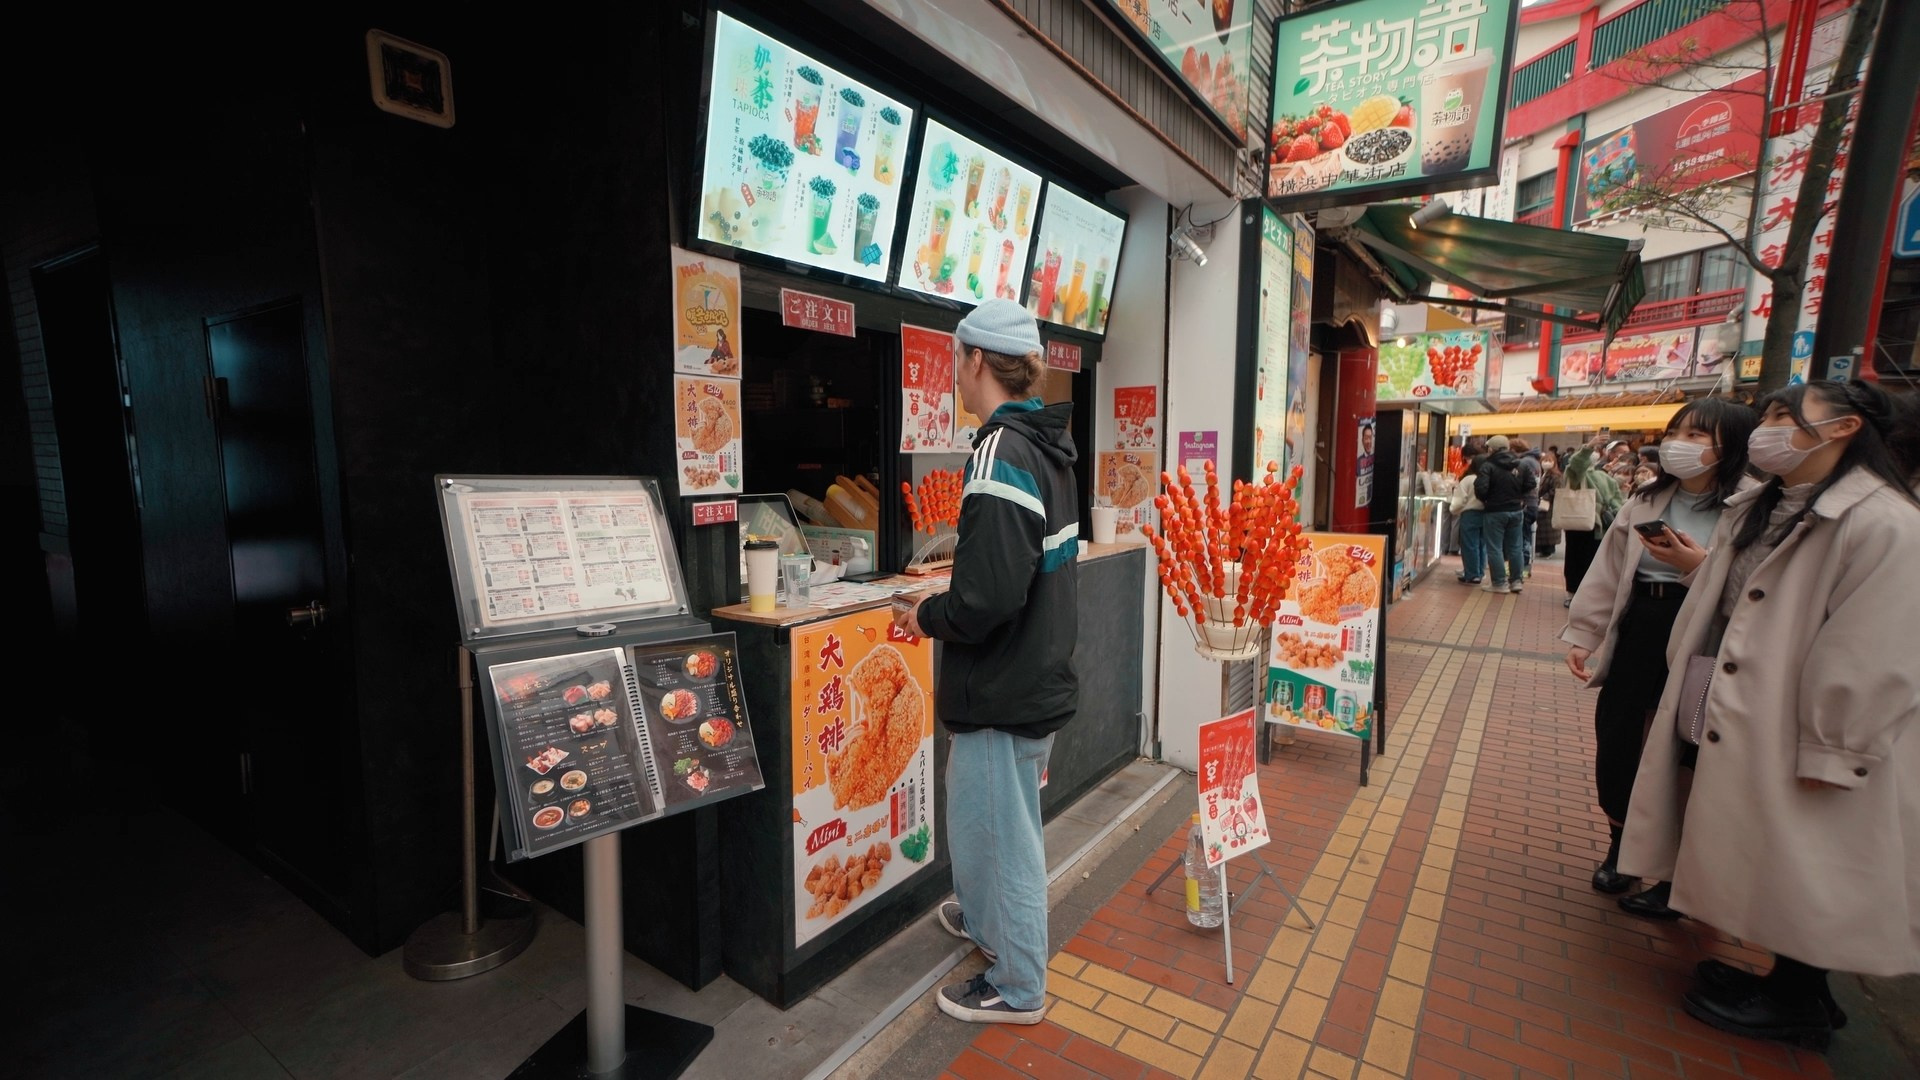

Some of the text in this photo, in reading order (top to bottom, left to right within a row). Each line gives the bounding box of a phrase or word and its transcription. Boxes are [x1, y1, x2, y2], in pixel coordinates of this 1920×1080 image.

[1299, 0, 1488, 97] 茶物語
[1325, 69, 1390, 93] TEA STORY
[732, 98, 770, 122] TAPIOCA
[1431, 104, 1472, 125] 茶物語
[1278, 163, 1408, 195] 横浜中華街店
[680, 261, 706, 279] HOT
[790, 297, 848, 324] ご注文口
[1050, 345, 1078, 361] お渡し口
[706, 383, 722, 397] Big
[1184, 441, 1215, 451] Instagram
[697, 505, 732, 518] ご注文口
[1350, 545, 1375, 563] Big
[1280, 615, 1300, 625] Mini
[724, 649, 743, 728] オリジナル盛り合わせ
[817, 633, 846, 755] 大鶏排
[919, 750, 927, 823] スパイスを選べる
[811, 821, 841, 850] Mini
